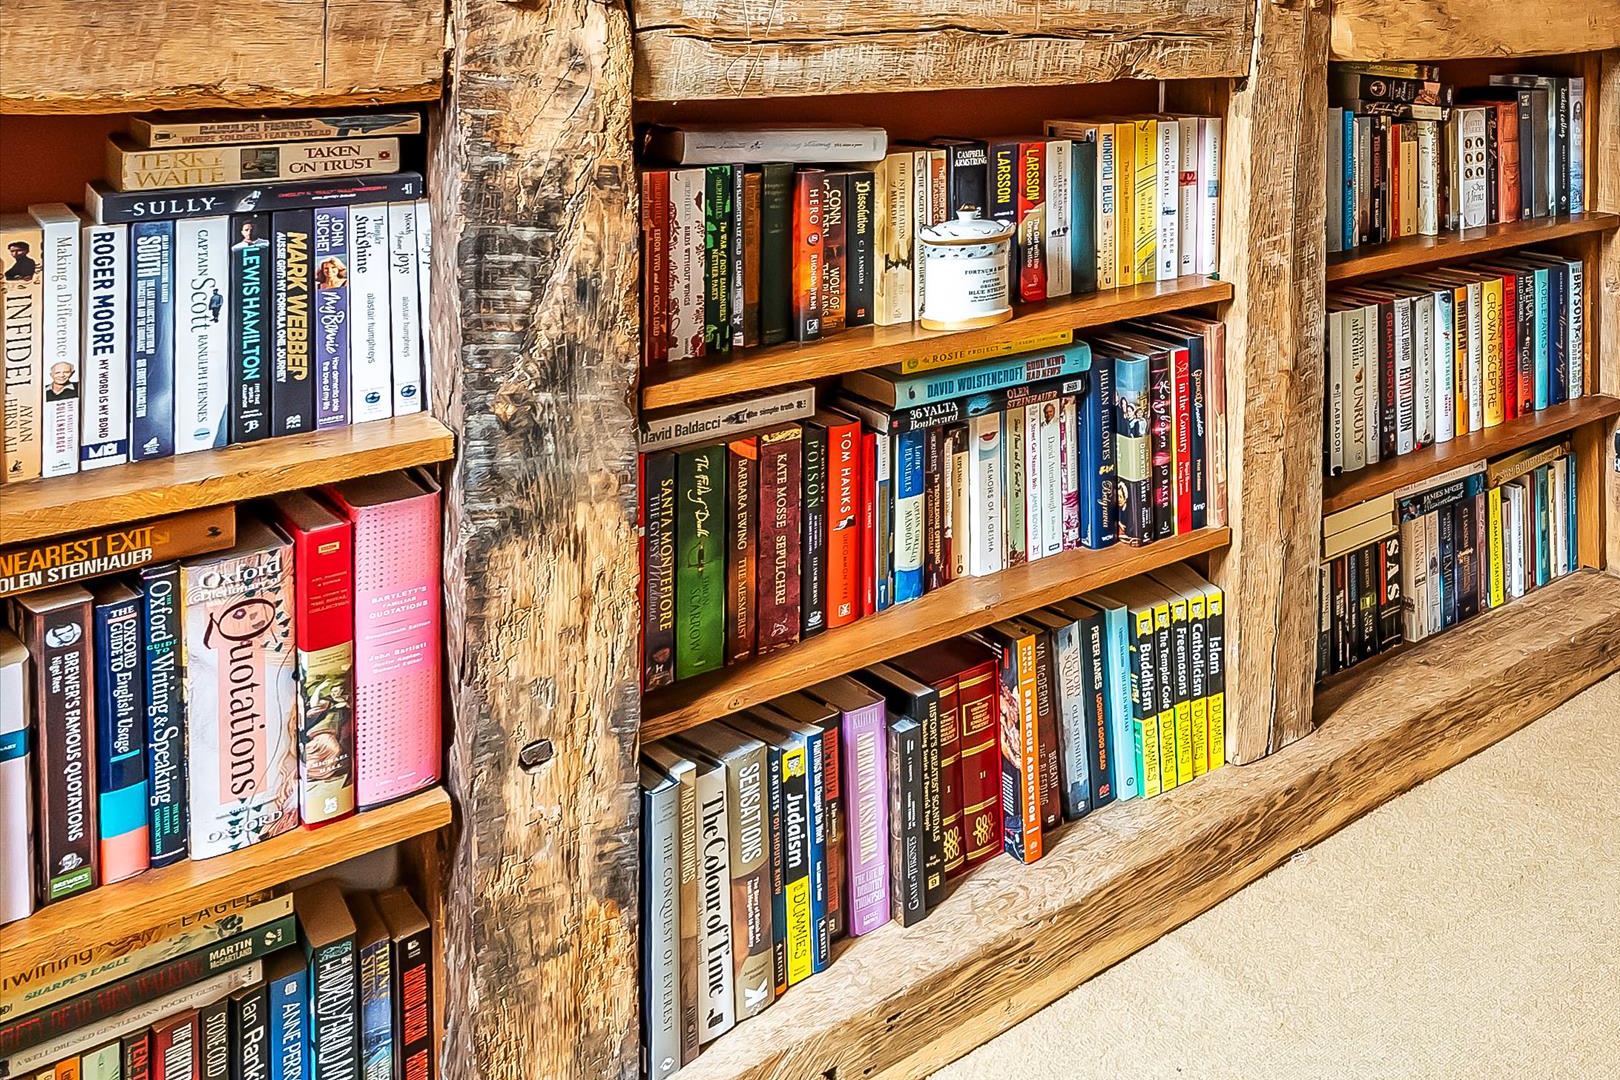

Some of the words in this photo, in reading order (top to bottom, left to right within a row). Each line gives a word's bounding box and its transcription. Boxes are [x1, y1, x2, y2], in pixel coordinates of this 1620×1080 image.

[134, 151, 225, 170] TERRY
[288, 161, 319, 173] ON
[319, 157, 375, 172] TRUST
[304, 145, 361, 158] TAKEN
[954, 156, 987, 167] ARMSTRONG
[957, 149, 985, 159] CAMPBELL
[1026, 149, 1040, 202] LARSSON
[1102, 133, 1112, 182] MONOPOLI
[134, 168, 226, 186] WAITE
[997, 151, 1011, 204] LARSSON
[1102, 185, 1112, 214] BLUES
[132, 197, 217, 216] SULLY
[809, 188, 819, 225] HERO
[855, 181, 871, 235] Dissolution
[286, 231, 309, 276] MARK
[316, 214, 330, 252] SUCHET
[331, 217, 343, 247] JOHN
[355, 215, 368, 274] Sunshine
[56, 236, 72, 281] Making
[92, 232, 114, 291] ROGER
[242, 247, 260, 299] LEWIS
[55, 287, 71, 358] Difference
[1487, 292, 1497, 341] CROWN
[1573, 272, 1582, 327] BRYSON
[92, 294, 114, 356] MOORE
[242, 301, 260, 381] HAMILTON
[286, 280, 309, 381] WEBBER
[931, 350, 965, 363] ROSIE
[967, 345, 999, 356] PROJECT
[927, 379, 956, 398] DAVID
[957, 365, 1024, 392] WOLSTENCROFT
[1006, 391, 1058, 408] STEINHAUER
[1487, 355, 1497, 409] SCEPTRE
[641, 421, 672, 444] David
[674, 416, 721, 437] Baldacci
[909, 408, 923, 419] 36
[923, 402, 959, 418] YALTA
[1101, 406, 1111, 459] FELLOWES
[1353, 382, 1364, 445] UNRULY
[776, 454, 787, 488] KATE
[841, 432, 852, 462] TOM
[737, 459, 748, 506] BARBARA
[806, 439, 819, 509] POISON
[840, 466, 852, 513] HANKS
[1423, 490, 1442, 504] JAMES
[660, 478, 673, 528] SANTA
[776, 490, 787, 528] MOSSE
[737, 508, 748, 550] EWING
[48, 548, 153, 582] STEINHAUER
[198, 554, 282, 590] Oxford
[659, 531, 674, 631] MONTEFIORE
[775, 534, 787, 606] SEPULCHRE
[1386, 538, 1400, 601] SAS
[1090, 625, 1099, 652] PETER
[1176, 627, 1187, 696] Freemasons
[1192, 622, 1203, 697] Catholicism
[1208, 636, 1221, 674] Islam
[63, 651, 81, 709] BREWER'S
[1092, 654, 1102, 690] JAMES
[1139, 643, 1153, 712] Buddhism
[204, 598, 276, 799] Quotations
[64, 711, 82, 760] FAMOUS
[64, 764, 83, 842] QUOTATIONS
[701, 791, 725, 839] The
[739, 762, 762, 865] SENSATIONS
[786, 792, 806, 868] Judaism
[704, 837, 727, 911] Colour
[659, 868, 673, 945] CONQUEST
[706, 913, 729, 941] of
[208, 937, 252, 959] MARTIN
[707, 934, 731, 998] Time
[663, 973, 673, 1034] EVEREST
